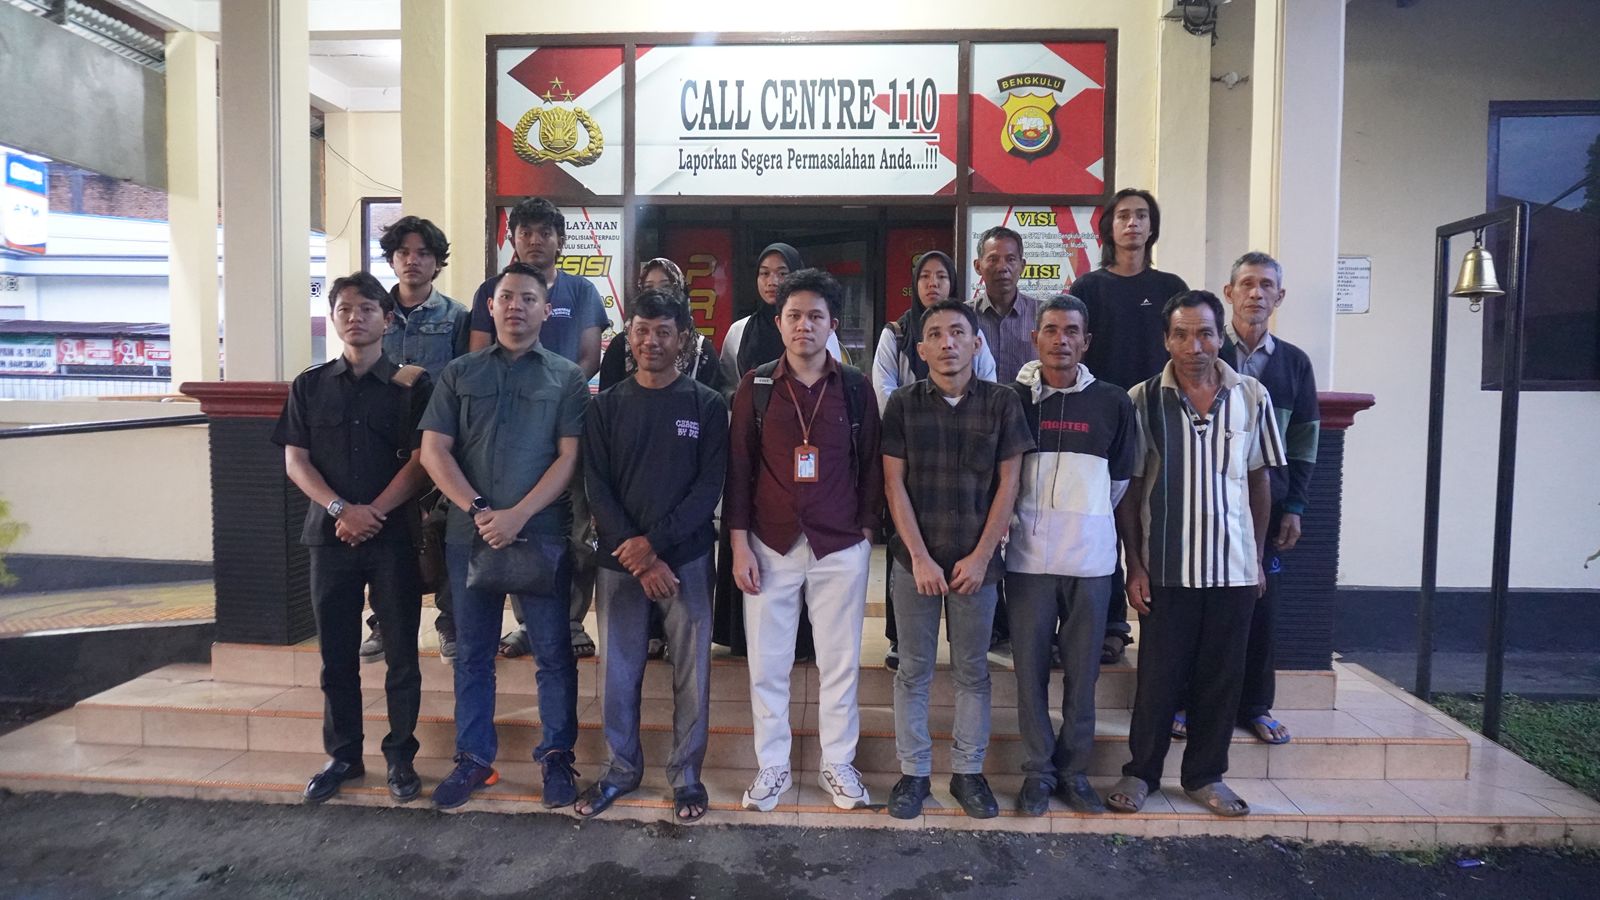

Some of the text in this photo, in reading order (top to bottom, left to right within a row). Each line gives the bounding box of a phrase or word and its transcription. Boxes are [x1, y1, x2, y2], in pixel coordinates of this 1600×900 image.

[1002, 77, 1061, 89] BENGKULU
[680, 78, 938, 131] CALL CENTRE 110
[678, 148, 737, 176] Laporkan
[741, 148, 783, 176] Segera
[787, 148, 876, 170] Permasalahan
[565, 221, 618, 230] LAYANAN
[1015, 211, 1057, 226] VISI
